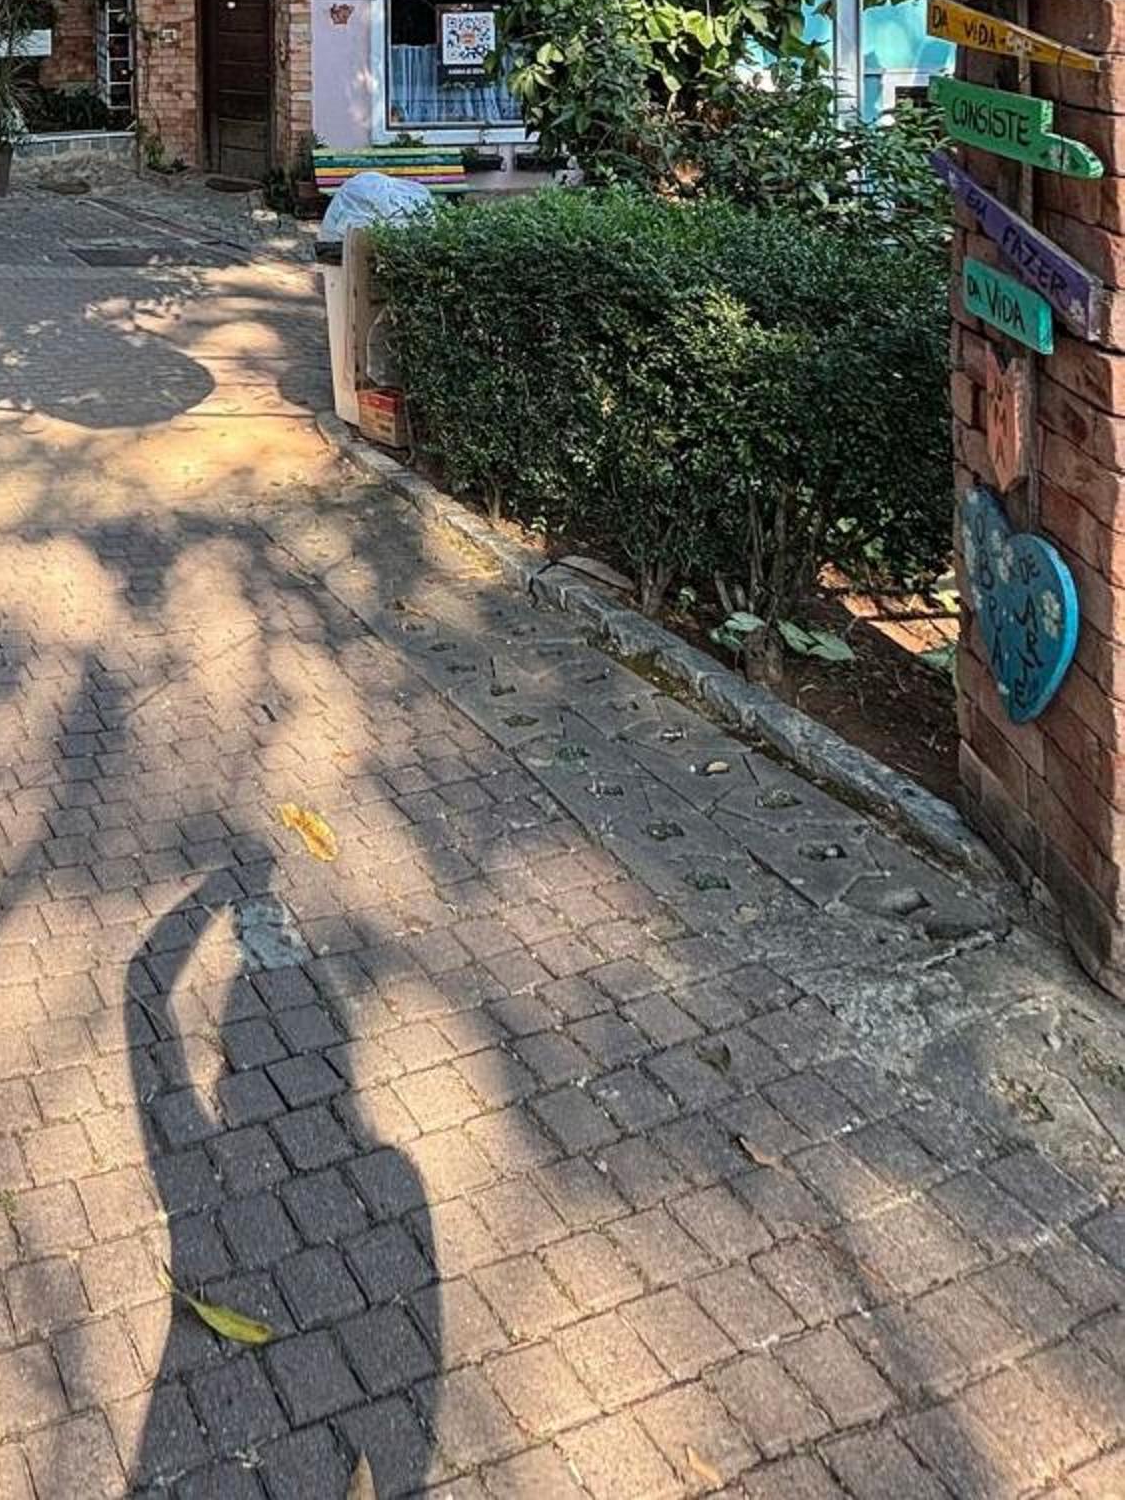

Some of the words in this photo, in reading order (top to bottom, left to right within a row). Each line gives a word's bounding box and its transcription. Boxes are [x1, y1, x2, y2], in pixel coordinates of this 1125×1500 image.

[932, 5, 949, 30] DA
[963, 21, 996, 47] VIDA
[951, 96, 1032, 146] CONSISTE
[1002, 225, 1069, 305] FAZER
[967, 275, 981, 302] DA
[985, 278, 1026, 335] VIDA
